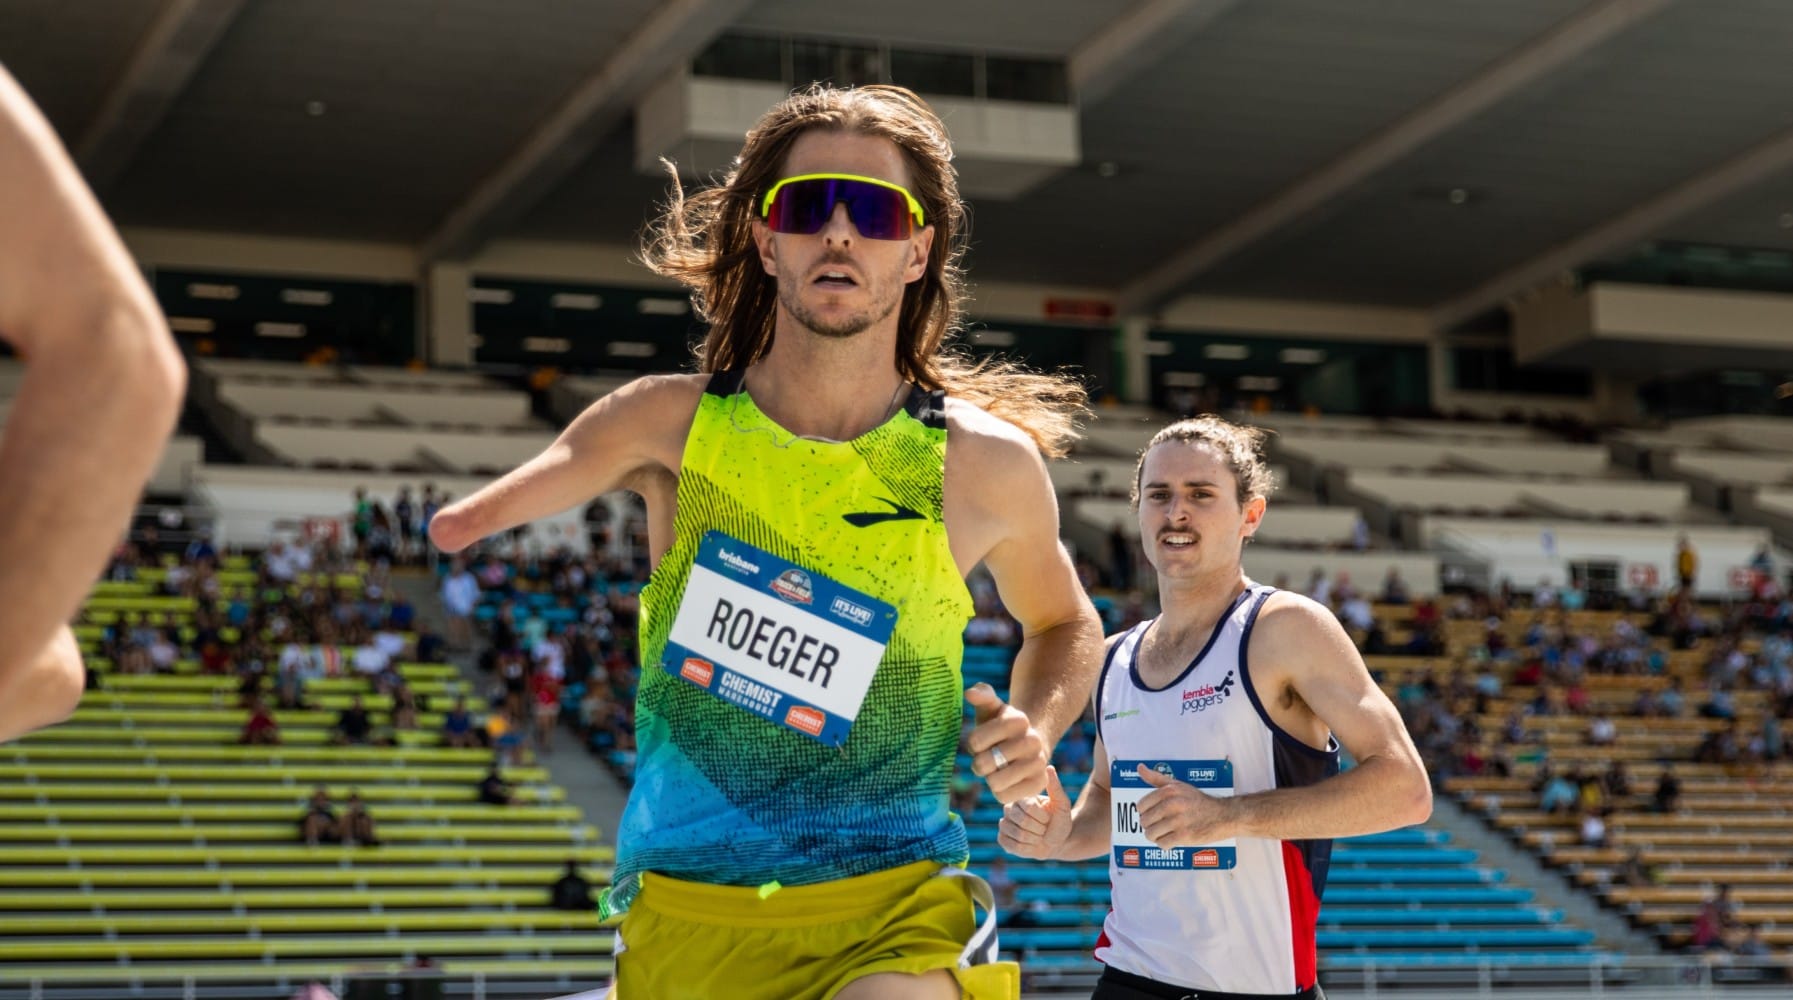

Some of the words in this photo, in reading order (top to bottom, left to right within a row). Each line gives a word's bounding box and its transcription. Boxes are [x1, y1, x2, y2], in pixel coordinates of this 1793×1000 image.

[718, 547, 760, 574] brisbane
[706, 597, 840, 689] ROEGER
[717, 686, 774, 717] WAREHOUSE
[721, 671, 783, 708] CHEMIST
[1182, 683, 1215, 700] kembla
[1180, 693, 1224, 716] joggers
[1144, 849, 1185, 861] CHEMIST
